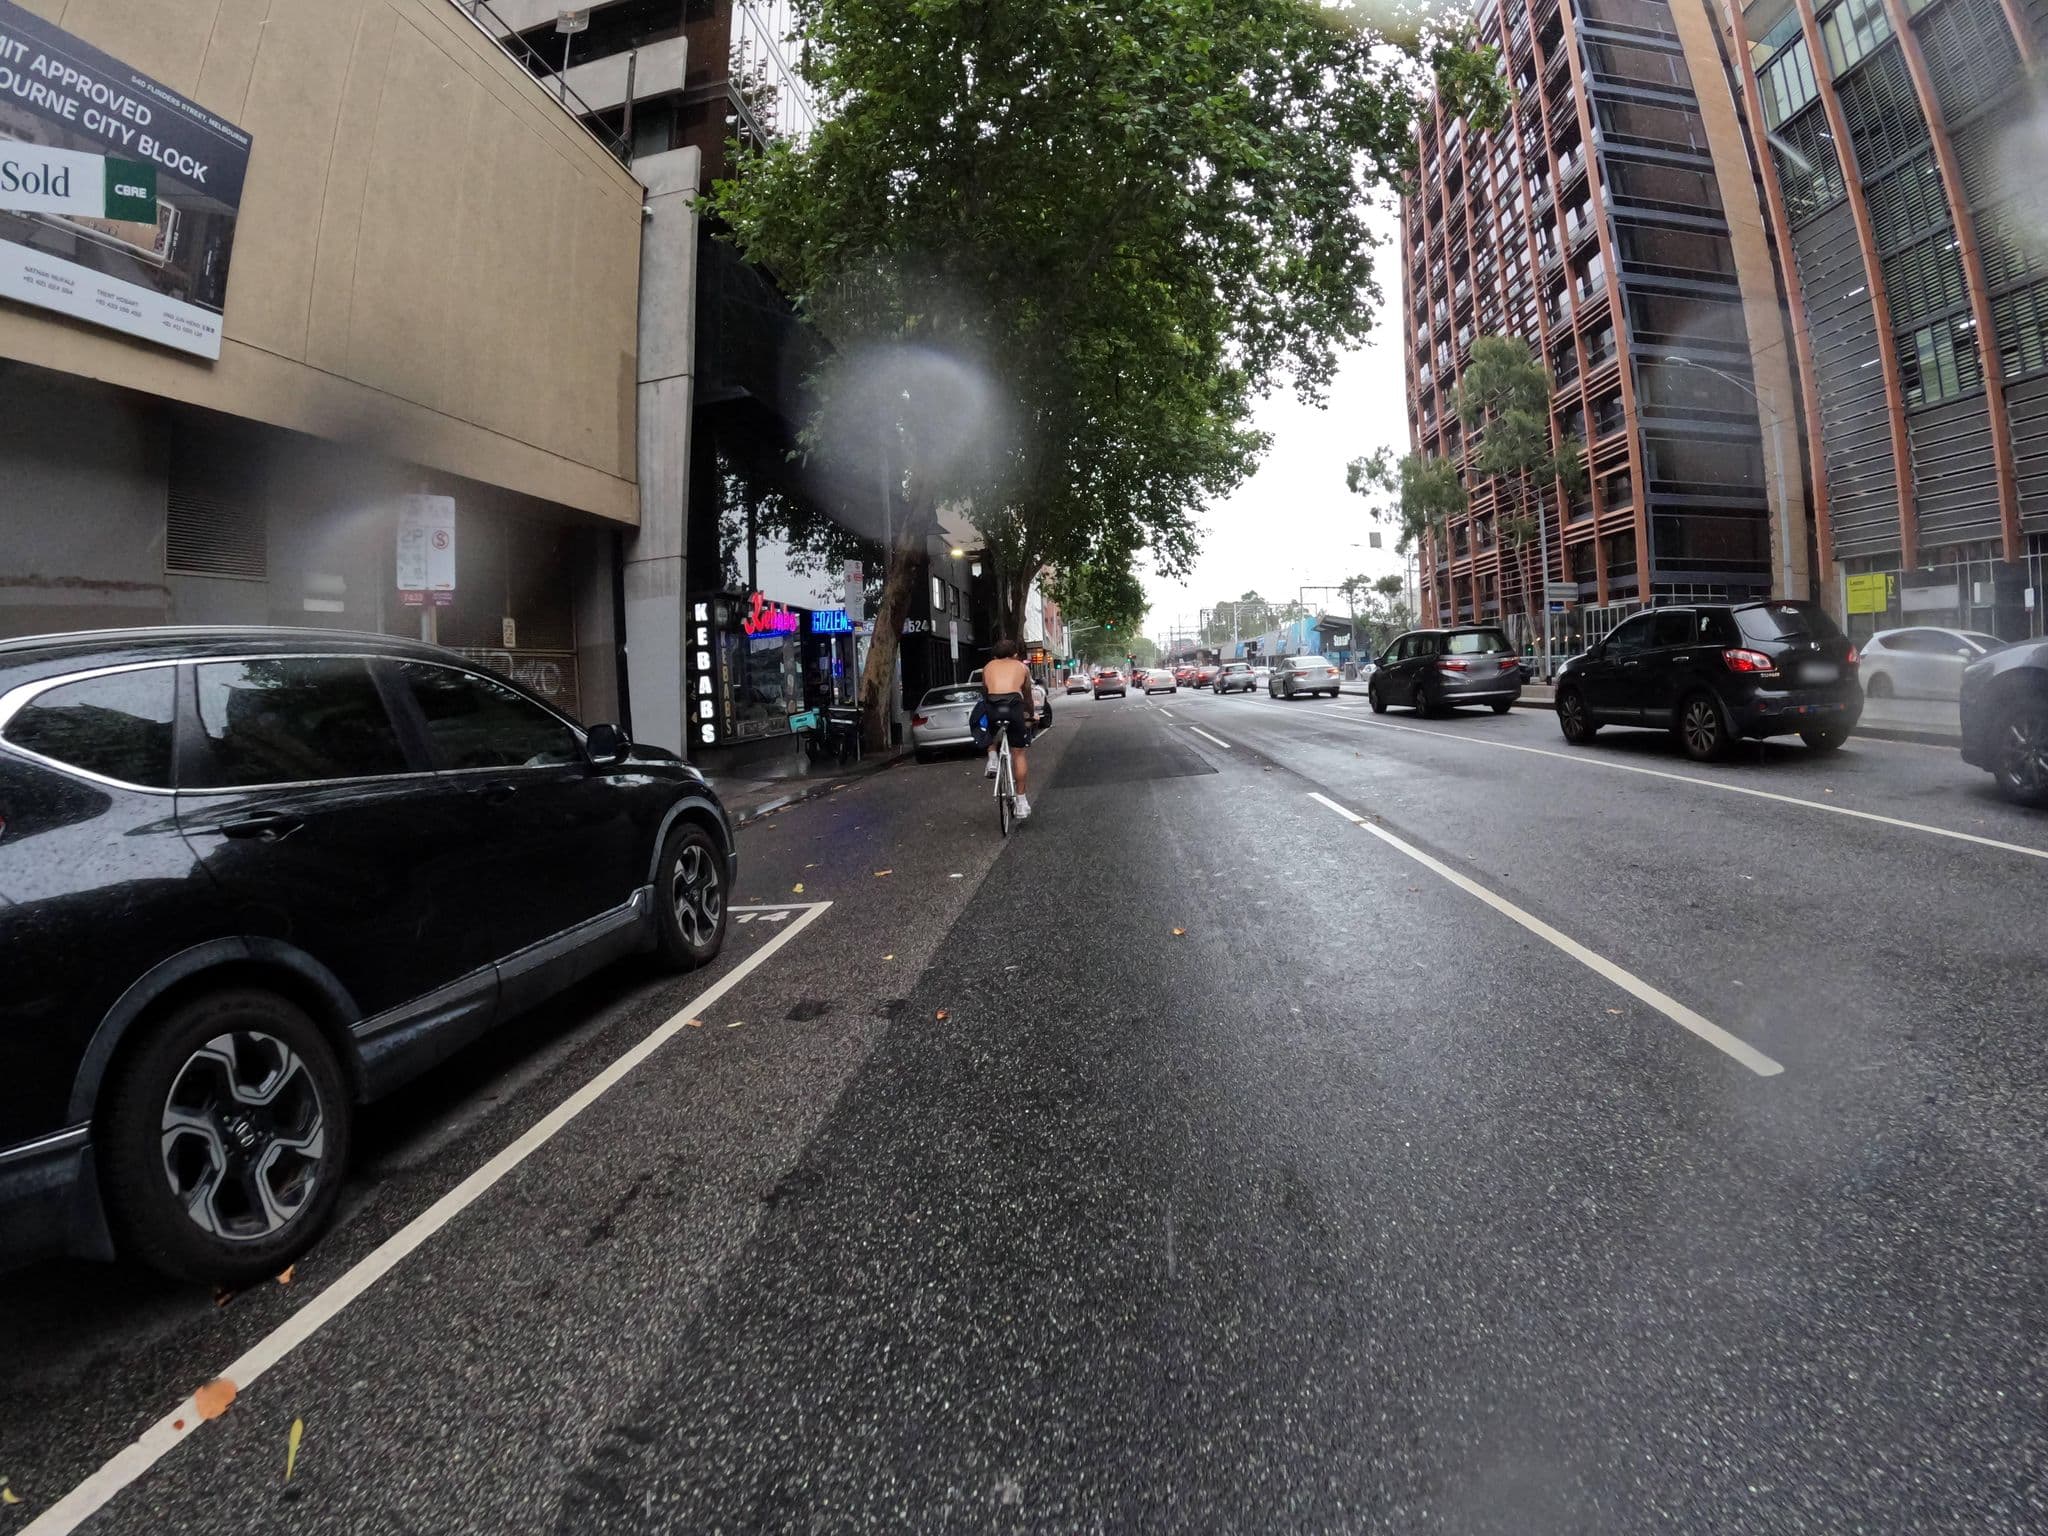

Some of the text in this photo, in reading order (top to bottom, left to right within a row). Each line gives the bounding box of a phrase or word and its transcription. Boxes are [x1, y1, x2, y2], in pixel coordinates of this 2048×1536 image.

[30, 54, 152, 125] APPROVED
[147, 84, 181, 107] FLINDERS
[208, 118, 248, 145] MELBOURNE
[1, 160, 70, 197] Sold
[83, 108, 136, 146] CITY
[138, 134, 208, 184] BLOCK
[114, 184, 147, 198] CBRE
[694, 603, 715, 743] KEBABS
[721, 631, 732, 735] KEBABS
